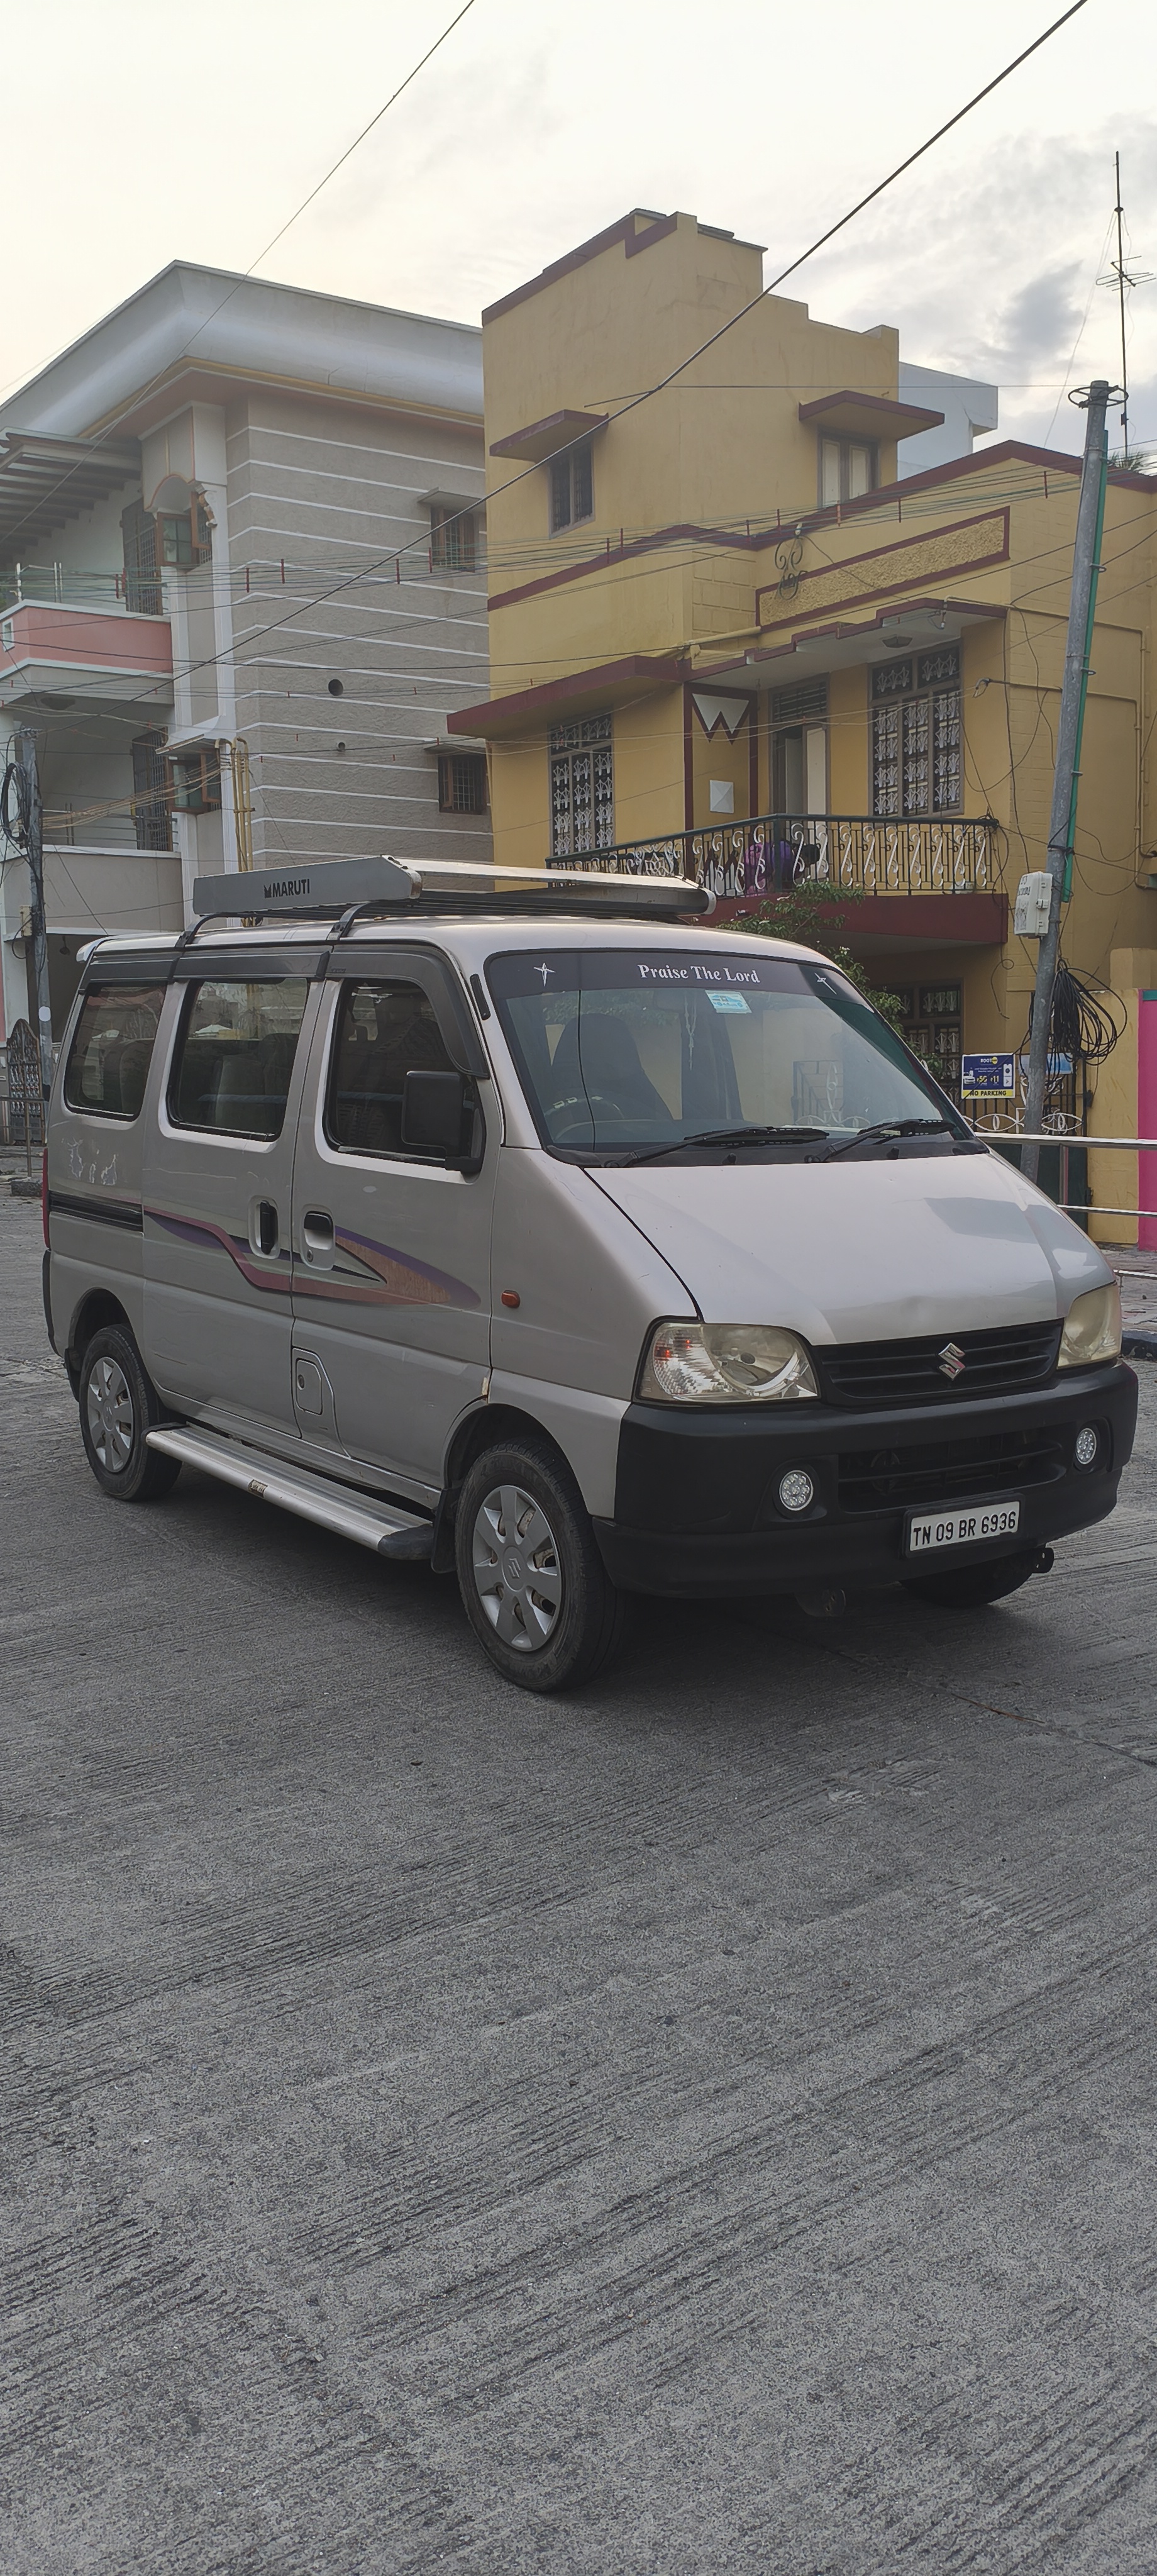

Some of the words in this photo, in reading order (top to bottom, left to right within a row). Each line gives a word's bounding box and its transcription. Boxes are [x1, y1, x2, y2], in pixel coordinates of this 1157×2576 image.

[272, 879, 310, 897] MARUTI
[638, 965, 689, 979] Praise
[690, 965, 722, 980] The
[723, 967, 760, 983] Lord
[914, 1526, 931, 1546] TN
[936, 1522, 954, 1541] 09
[959, 1518, 977, 1538] BR
[982, 1511, 1016, 1534] 6936
